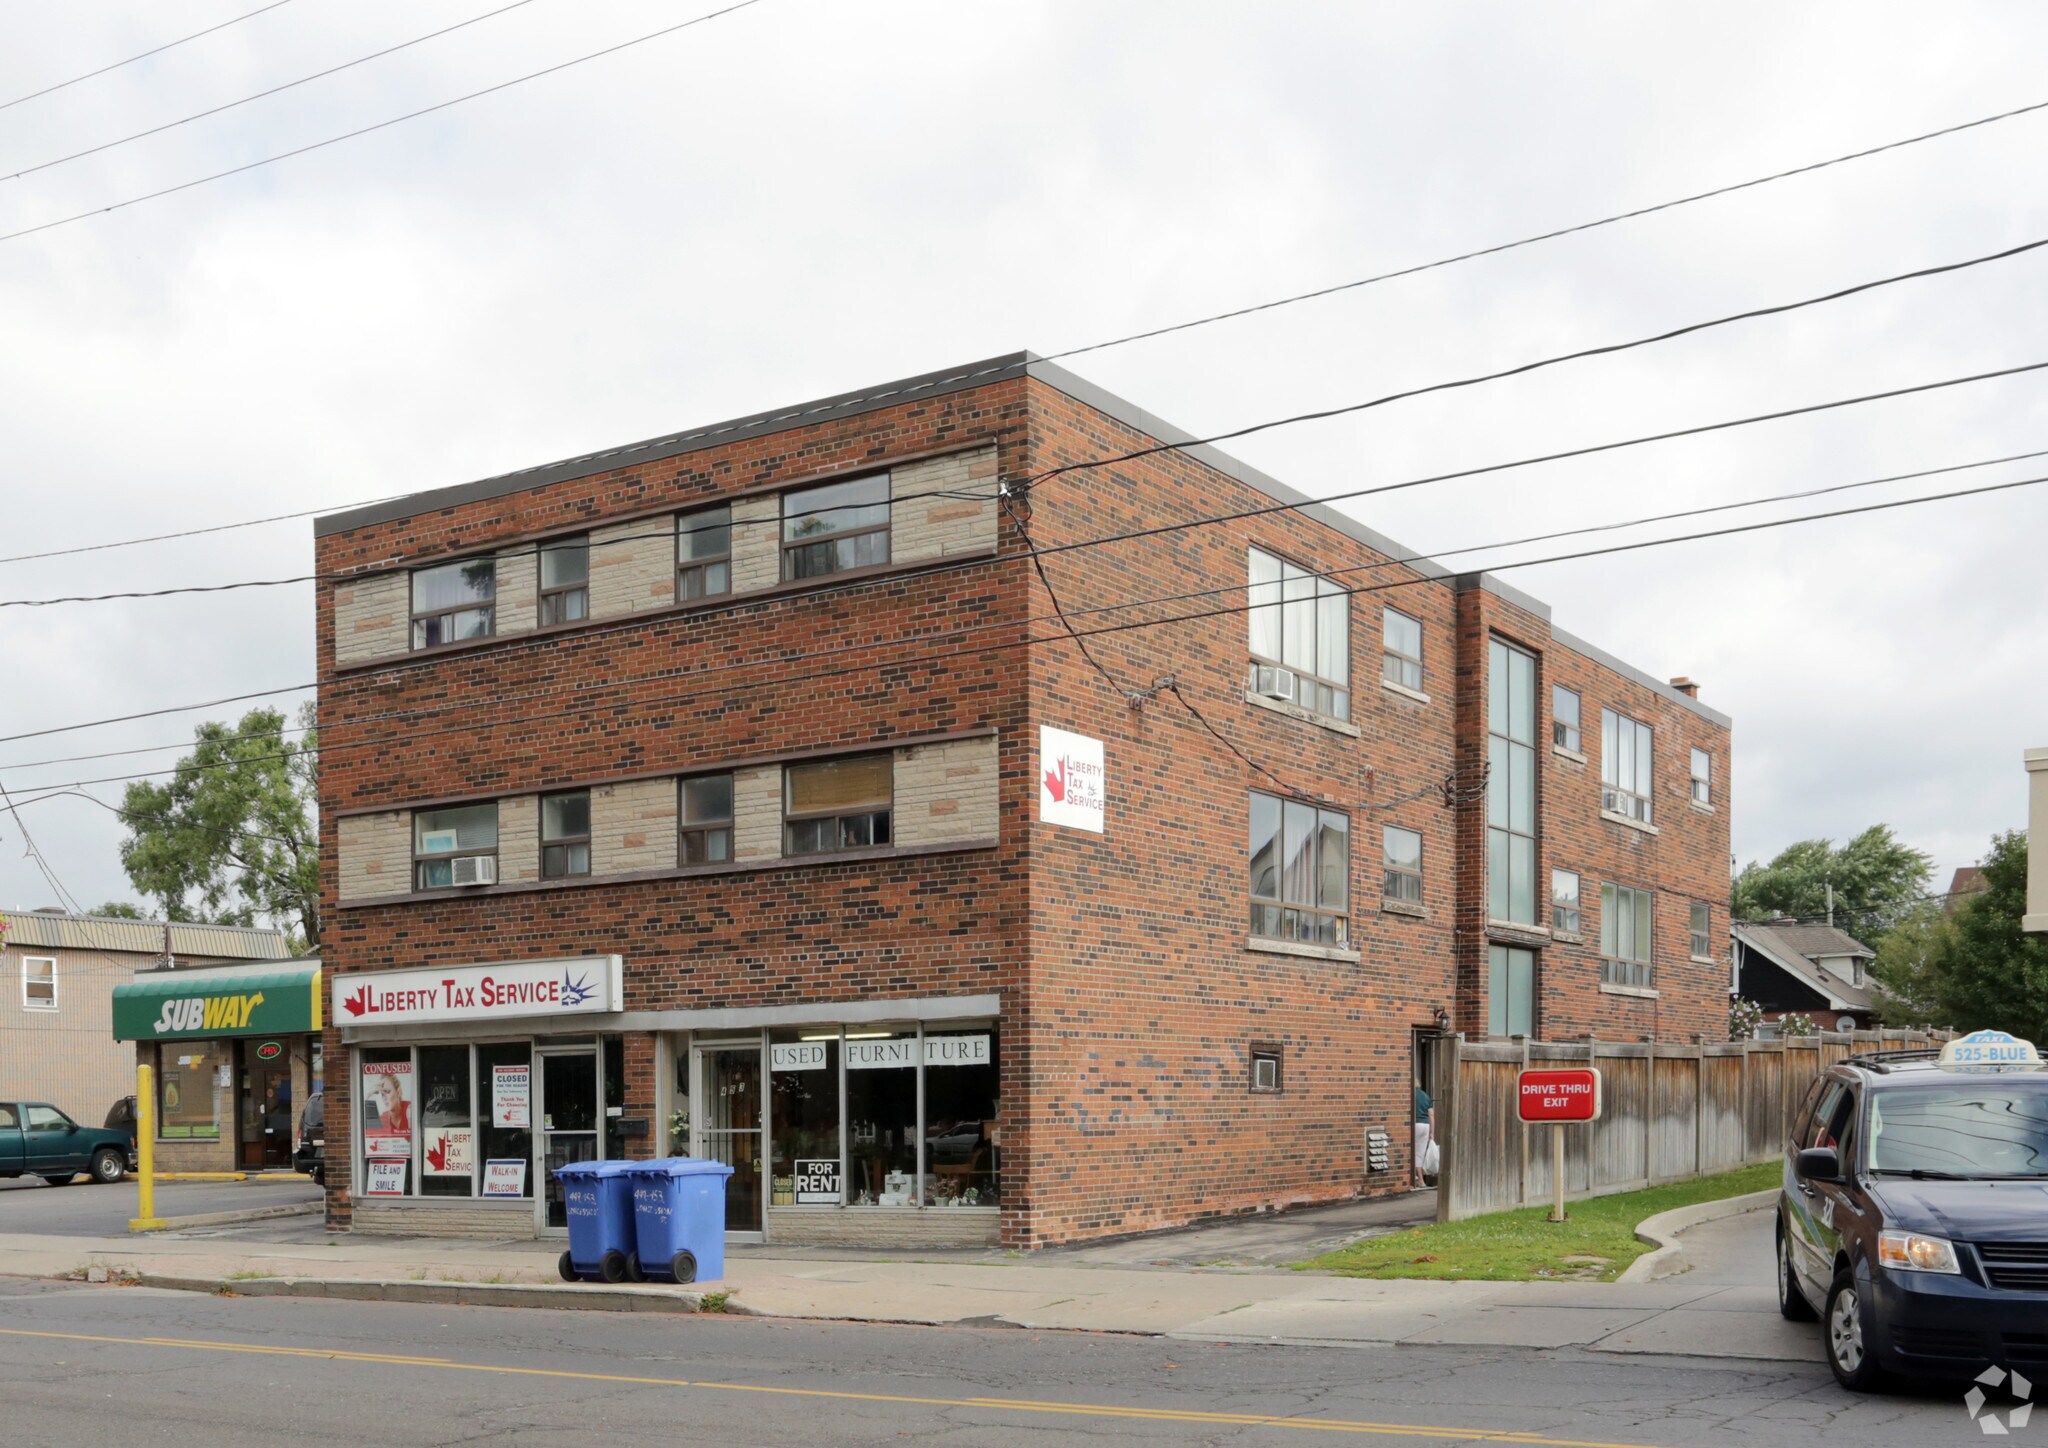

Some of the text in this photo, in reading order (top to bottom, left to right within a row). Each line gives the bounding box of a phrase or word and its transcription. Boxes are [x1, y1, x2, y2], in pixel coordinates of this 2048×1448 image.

[1067, 754, 1102, 777] LIBERTY
[1067, 772, 1083, 790] TAX
[1066, 789, 1103, 811] SERVICE
[367, 976, 559, 1012] LIBERTY TAX SERVICE
[153, 991, 264, 1034] SUBWAY
[1974, 1035, 2005, 1043] TAXI
[260, 1045, 278, 1056] OPEN
[773, 1046, 824, 1065] USED
[1955, 1047, 2027, 1060] 525-BLUE
[364, 1063, 411, 1074] CONFUSED?
[497, 1074, 528, 1083] CLOSED
[433, 1086, 456, 1100] OPEN
[1522, 1083, 1591, 1095] DRIVE THRU
[1543, 1097, 1569, 1108] EXIT
[446, 1130, 471, 1143] LIBERT
[446, 1144, 461, 1158] TAX
[373, 1164, 401, 1175] FILE AND
[445, 1158, 472, 1172] SERVIC
[491, 1165, 518, 1176] WALK-IN
[808, 1162, 833, 1174] FOR
[375, 1180, 396, 1191] SMILE
[488, 1181, 519, 1193] WELCOME
[774, 1178, 793, 1186] CLOSED
[797, 1175, 841, 1192] RENT
